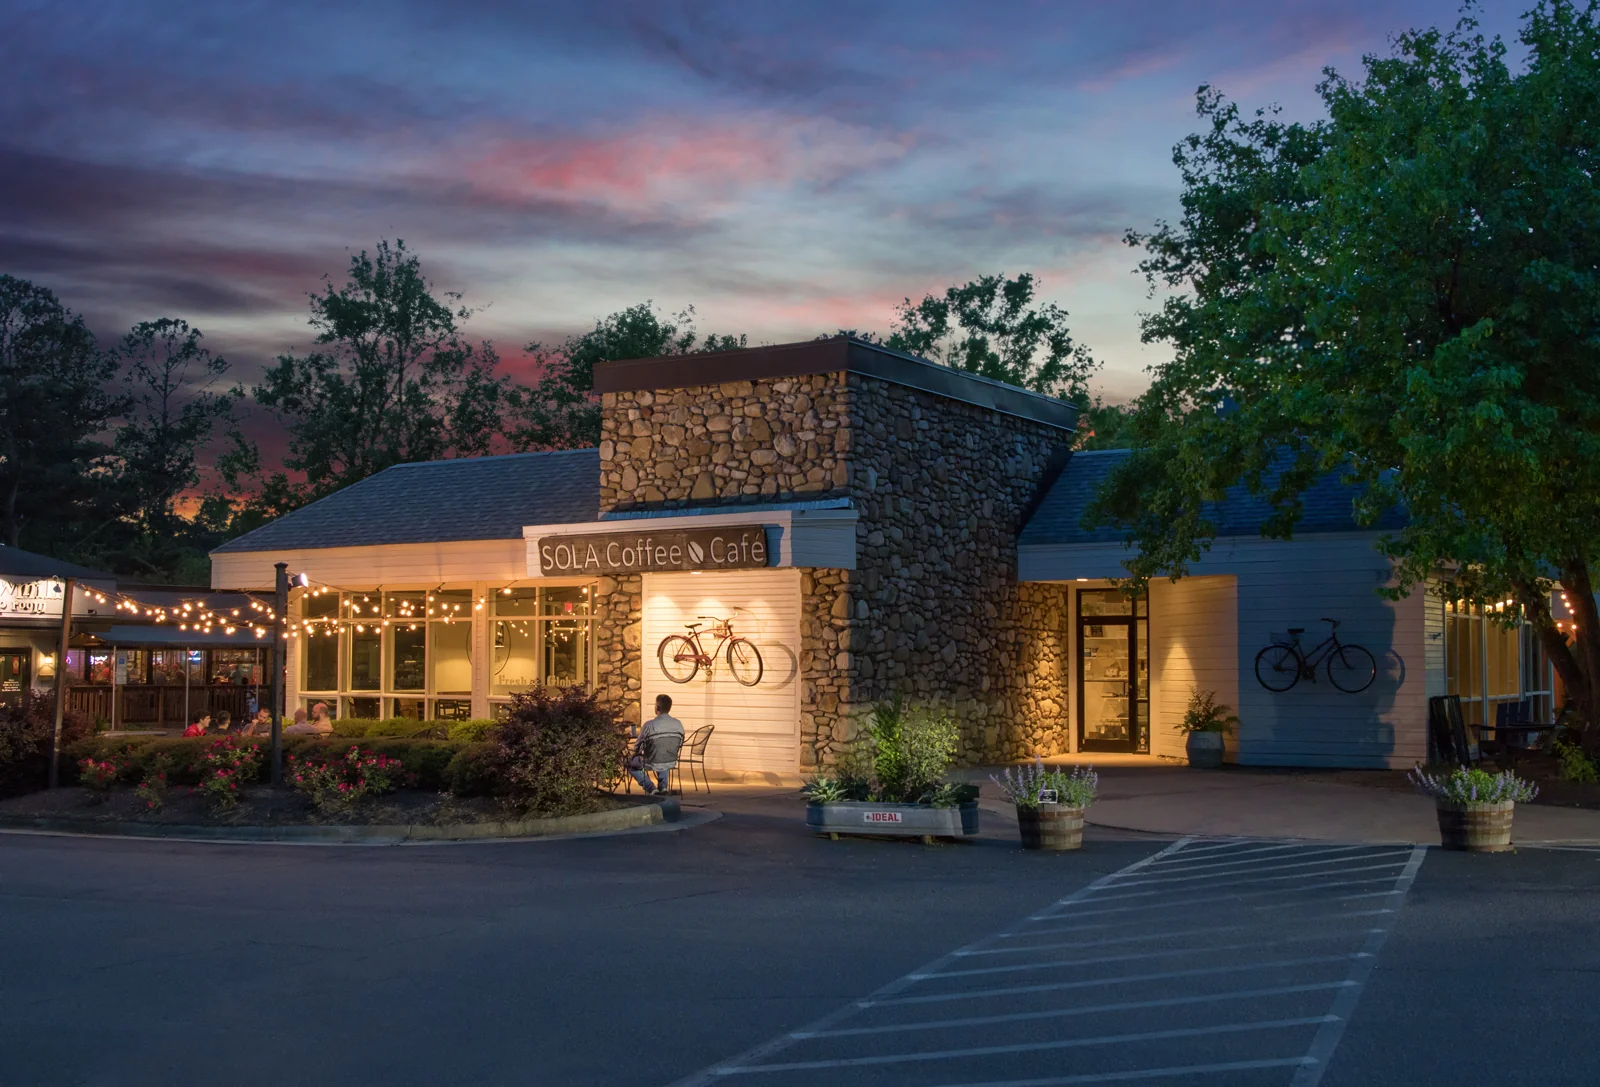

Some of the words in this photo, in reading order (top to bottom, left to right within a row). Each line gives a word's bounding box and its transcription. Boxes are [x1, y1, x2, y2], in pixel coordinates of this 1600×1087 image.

[542, 543, 600, 570] SOLA
[606, 538, 682, 567] Coffee
[710, 533, 764, 563] Café
[499, 673, 527, 685] Fresh
[872, 812, 899, 822] IDEAL
